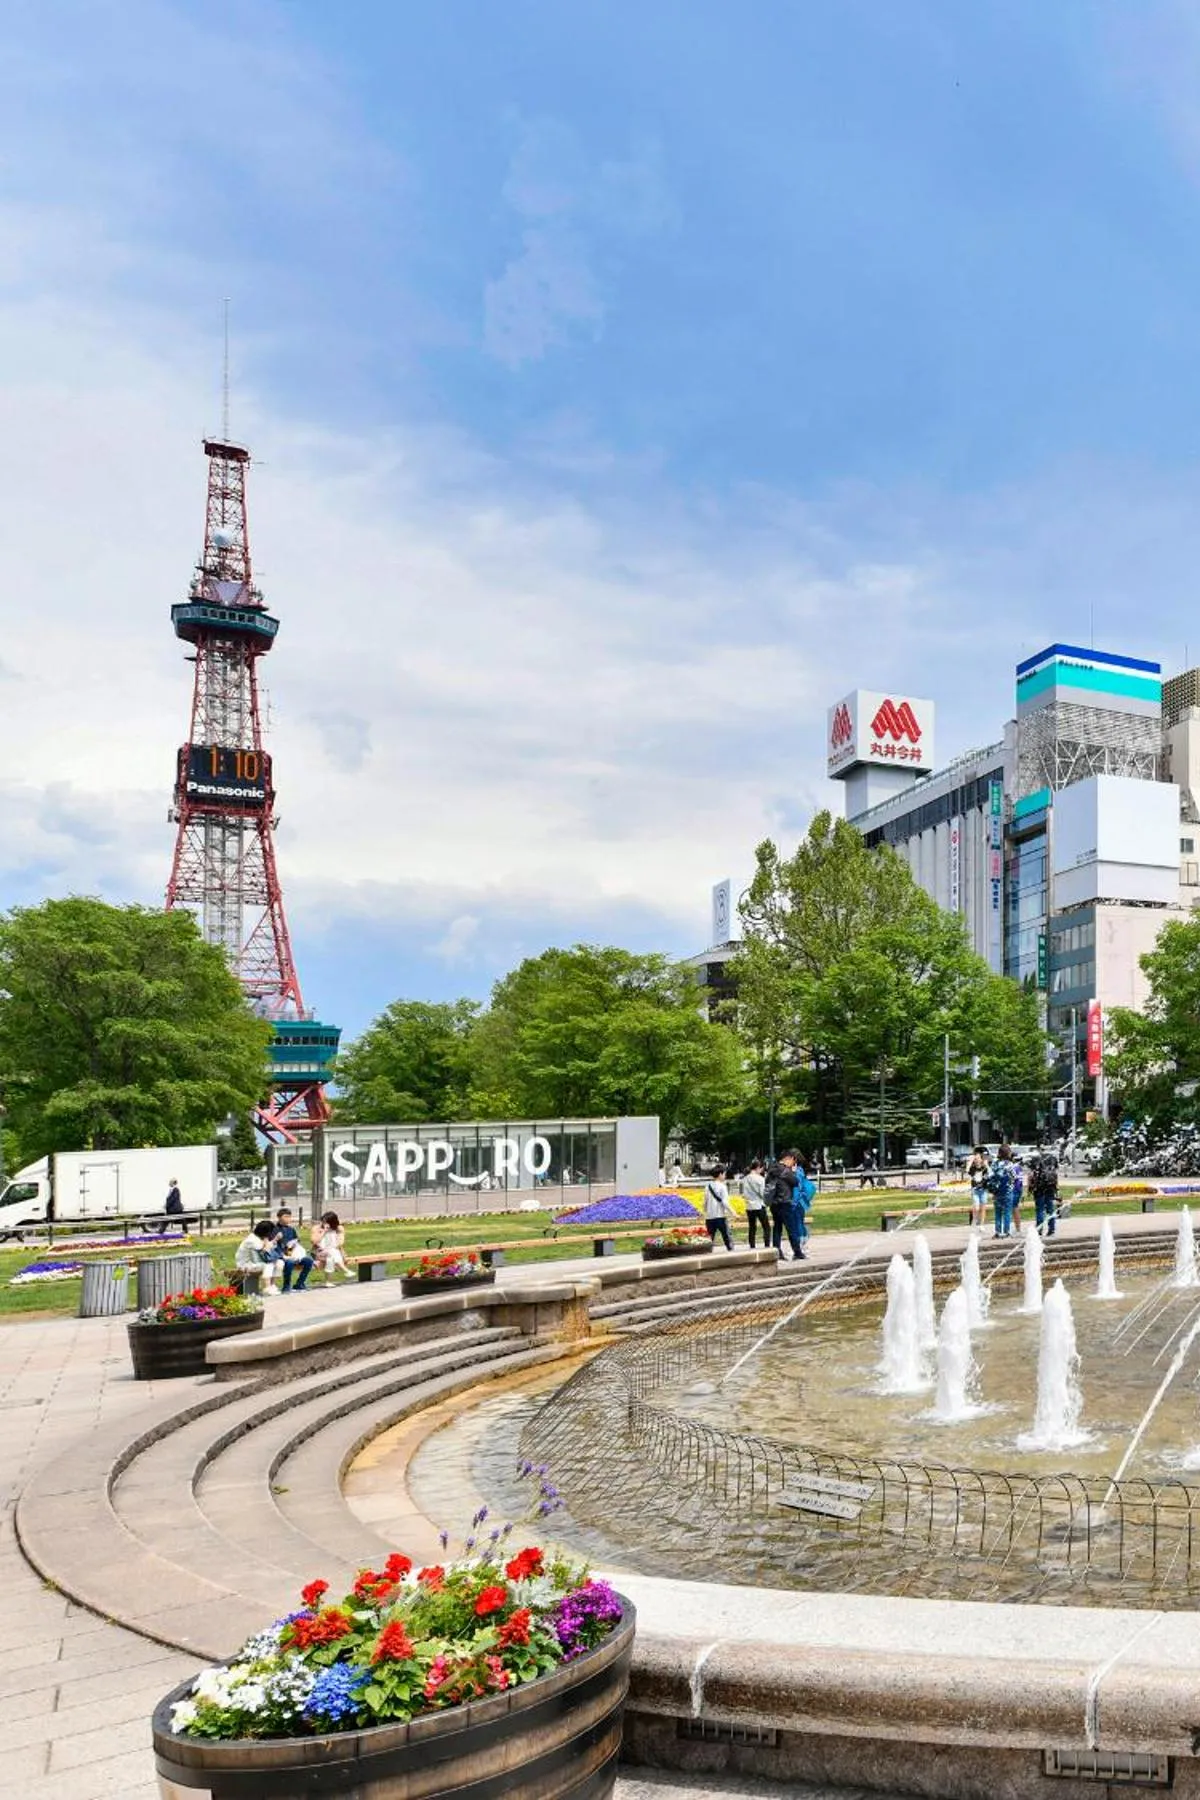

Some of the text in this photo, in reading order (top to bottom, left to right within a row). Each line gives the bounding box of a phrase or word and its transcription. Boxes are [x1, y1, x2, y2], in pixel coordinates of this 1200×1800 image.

[210, 744, 258, 780] 1:10
[870, 742, 922, 762] 丸井今井
[186, 781, 265, 798] Panasonic
